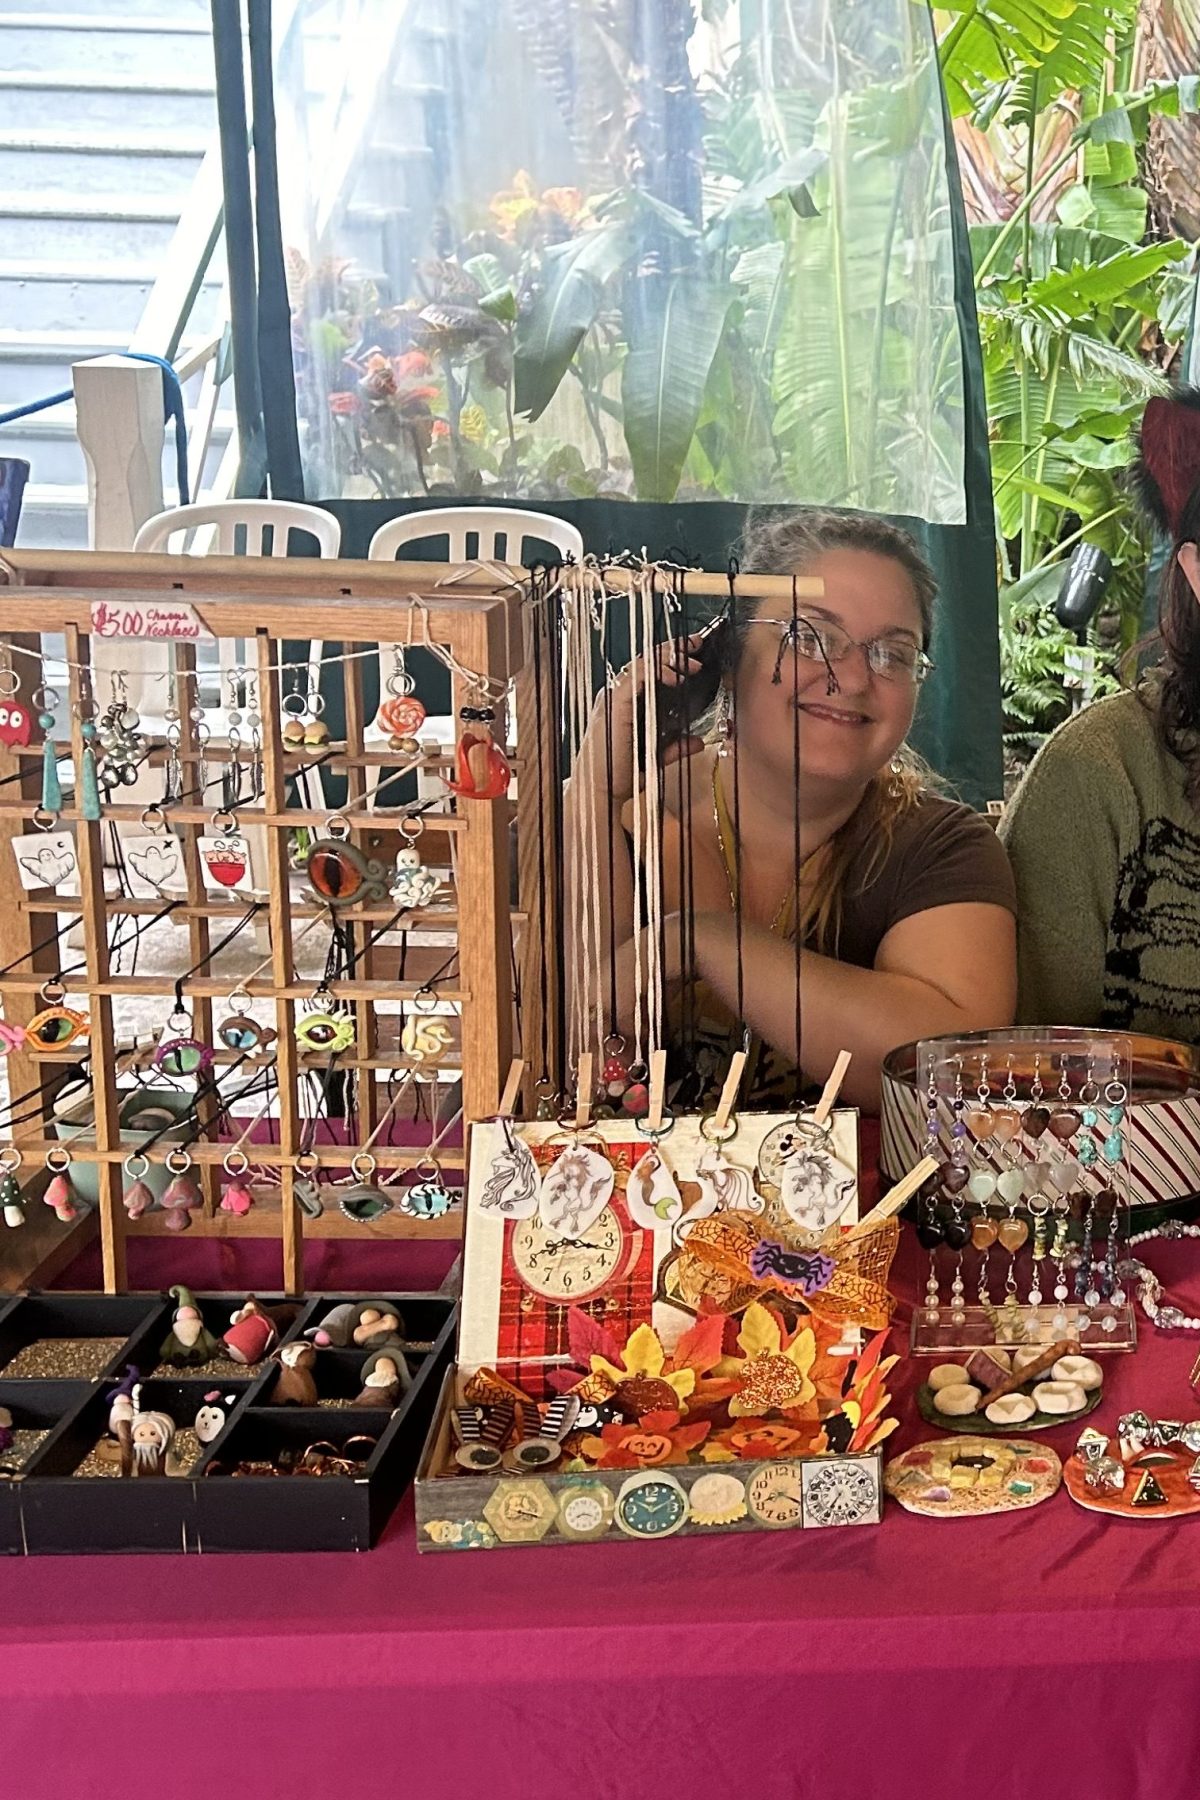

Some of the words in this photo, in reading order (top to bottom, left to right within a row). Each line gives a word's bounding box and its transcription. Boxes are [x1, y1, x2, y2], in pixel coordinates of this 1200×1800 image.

[531, 1216, 543, 1230] 10
[599, 1213, 608, 1228] 2
[524, 1234, 534, 1250] 9
[604, 1232, 615, 1248] 3
[529, 1253, 538, 1269] 8
[596, 1253, 607, 1267] 4
[543, 1267, 553, 1282] 7
[582, 1266, 592, 1281] 5
[562, 1271, 572, 1288] 6
[764, 1471, 773, 1480] 11
[775, 1466, 788, 1476] 12
[791, 1469, 797, 1478] 1
[755, 1480, 768, 1489] 10
[645, 1486, 659, 1497] 12
[751, 1491, 761, 1501] 9
[668, 1502, 679, 1513] 3
[756, 1502, 765, 1511] 8
[765, 1510, 774, 1519] 7
[776, 1512, 787, 1521] 6
[788, 1508, 798, 1518] 5
